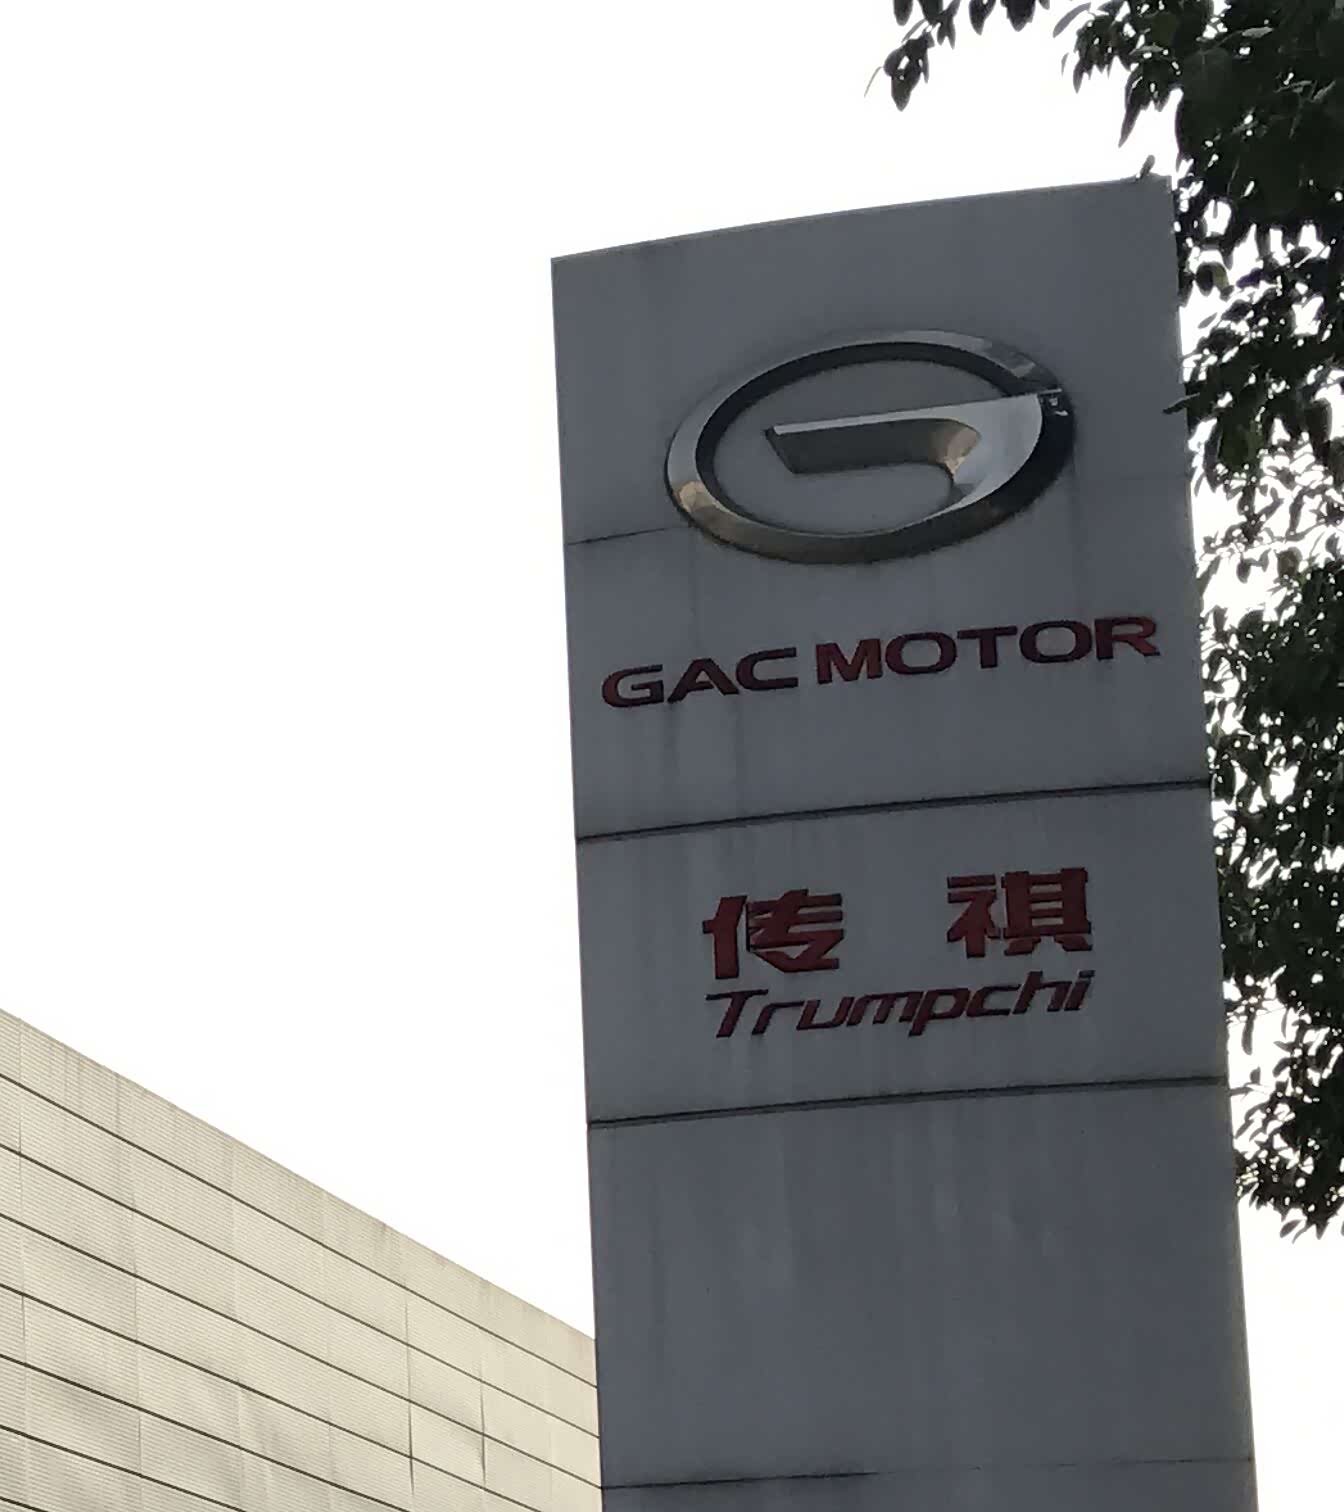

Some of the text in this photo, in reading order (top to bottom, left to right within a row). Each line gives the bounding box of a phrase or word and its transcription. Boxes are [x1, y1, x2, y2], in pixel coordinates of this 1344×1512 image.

[601, 615, 1161, 709] GAC MOTOR
[702, 867, 1093, 980] 传祺
[705, 969, 1096, 1039] Trumpchi
